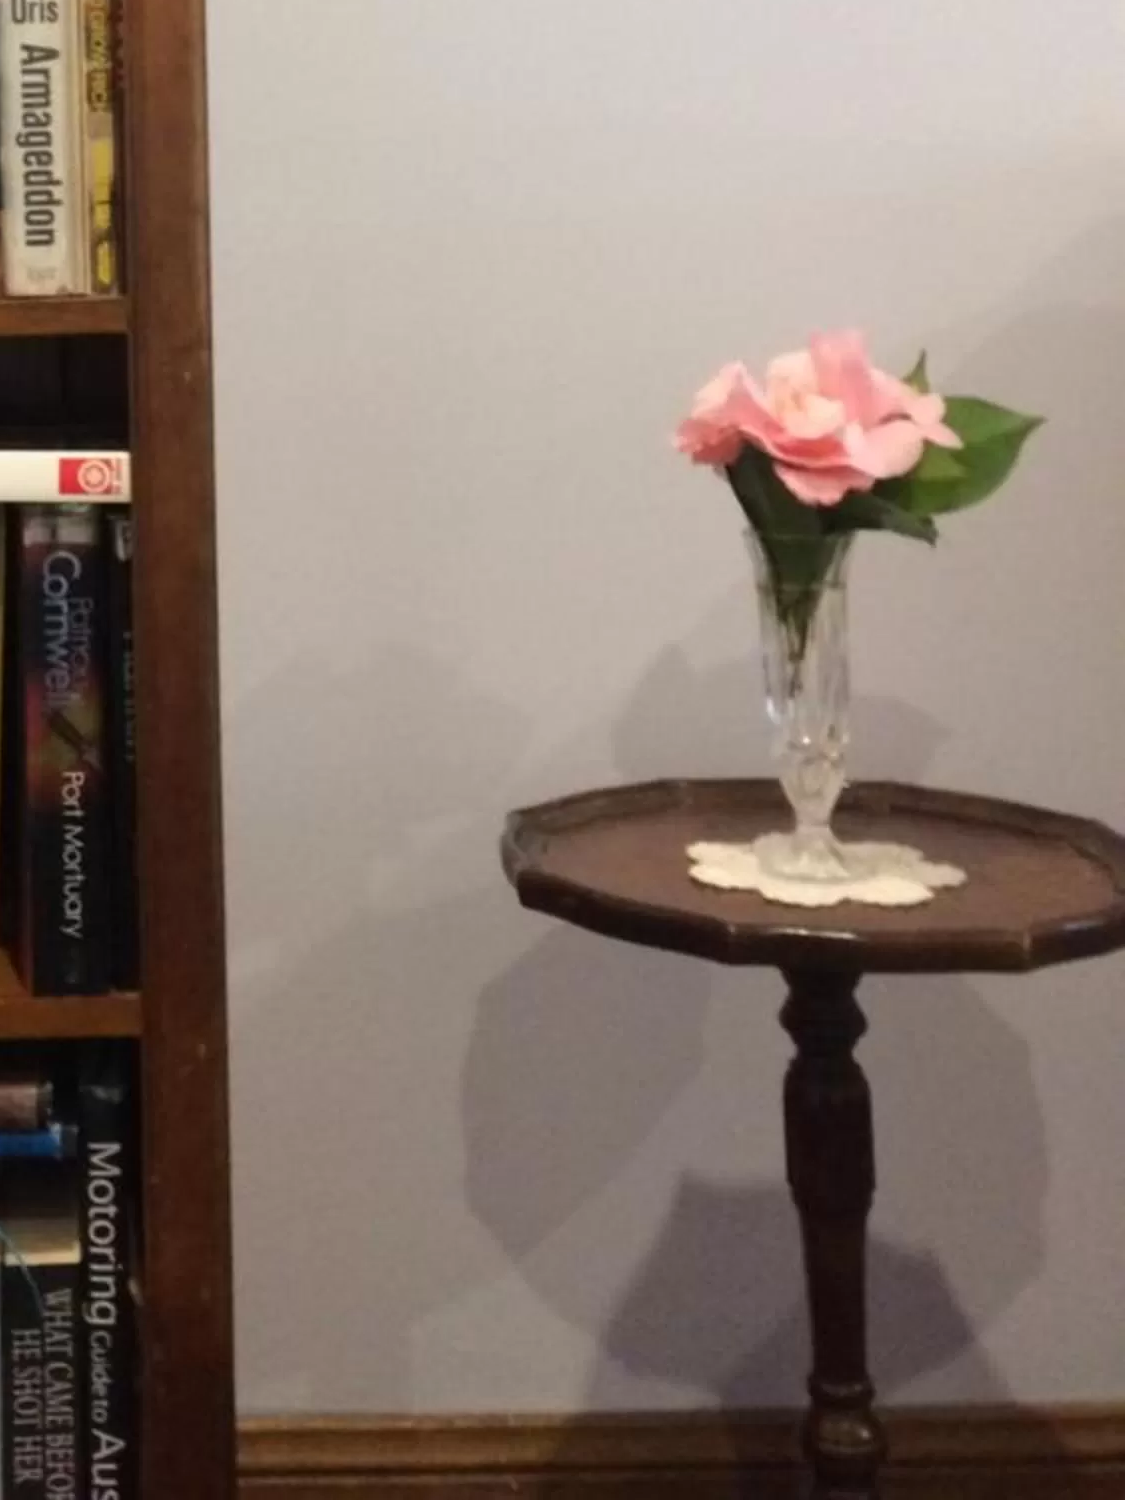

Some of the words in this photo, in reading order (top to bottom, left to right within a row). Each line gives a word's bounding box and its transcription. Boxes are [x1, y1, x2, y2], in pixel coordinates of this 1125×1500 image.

[16, 42, 61, 247] Armageddon
[40, 550, 82, 706] Cornwell
[61, 770, 87, 817] Port
[55, 823, 88, 940] Mortuary
[82, 1141, 123, 1327] Motoring
[11, 1328, 41, 1361] HE
[43, 1287, 75, 1357] WHAT
[45, 1360, 75, 1429] CAME
[90, 1329, 114, 1396] Guide
[12, 1365, 43, 1430] SHOT
[91, 1398, 109, 1423] to
[13, 1434, 45, 1485] HER
